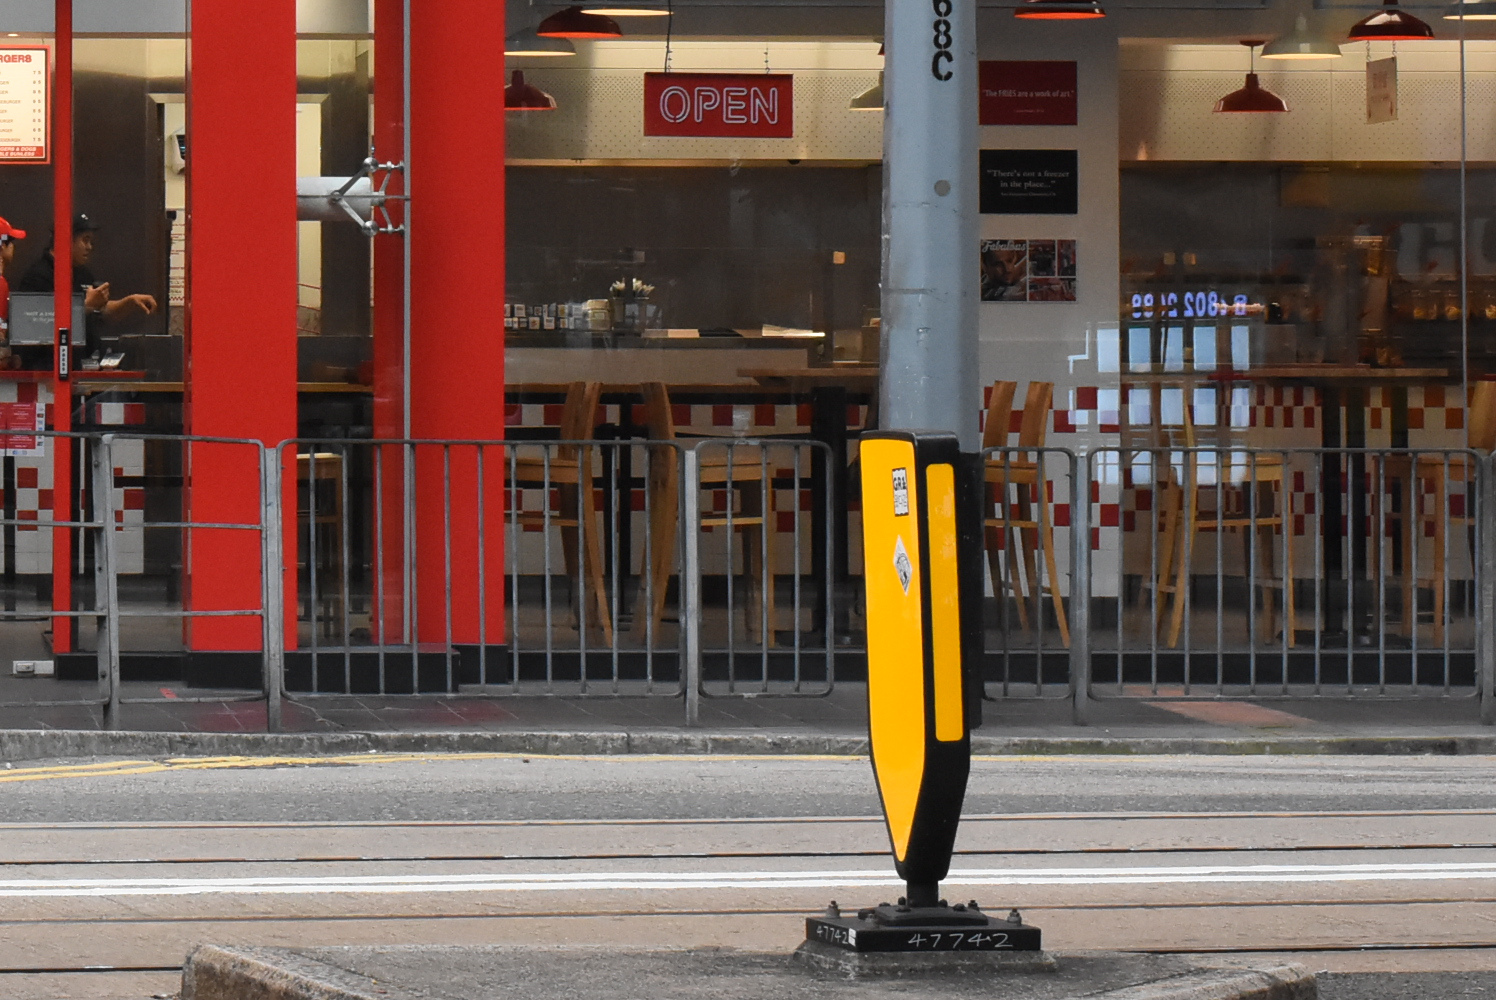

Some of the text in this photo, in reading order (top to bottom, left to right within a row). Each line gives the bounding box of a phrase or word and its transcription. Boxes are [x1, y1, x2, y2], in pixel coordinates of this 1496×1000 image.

[659, 85, 778, 125] OPEN
[816, 924, 849, 945] 47742
[908, 932, 1013, 949] 47742
